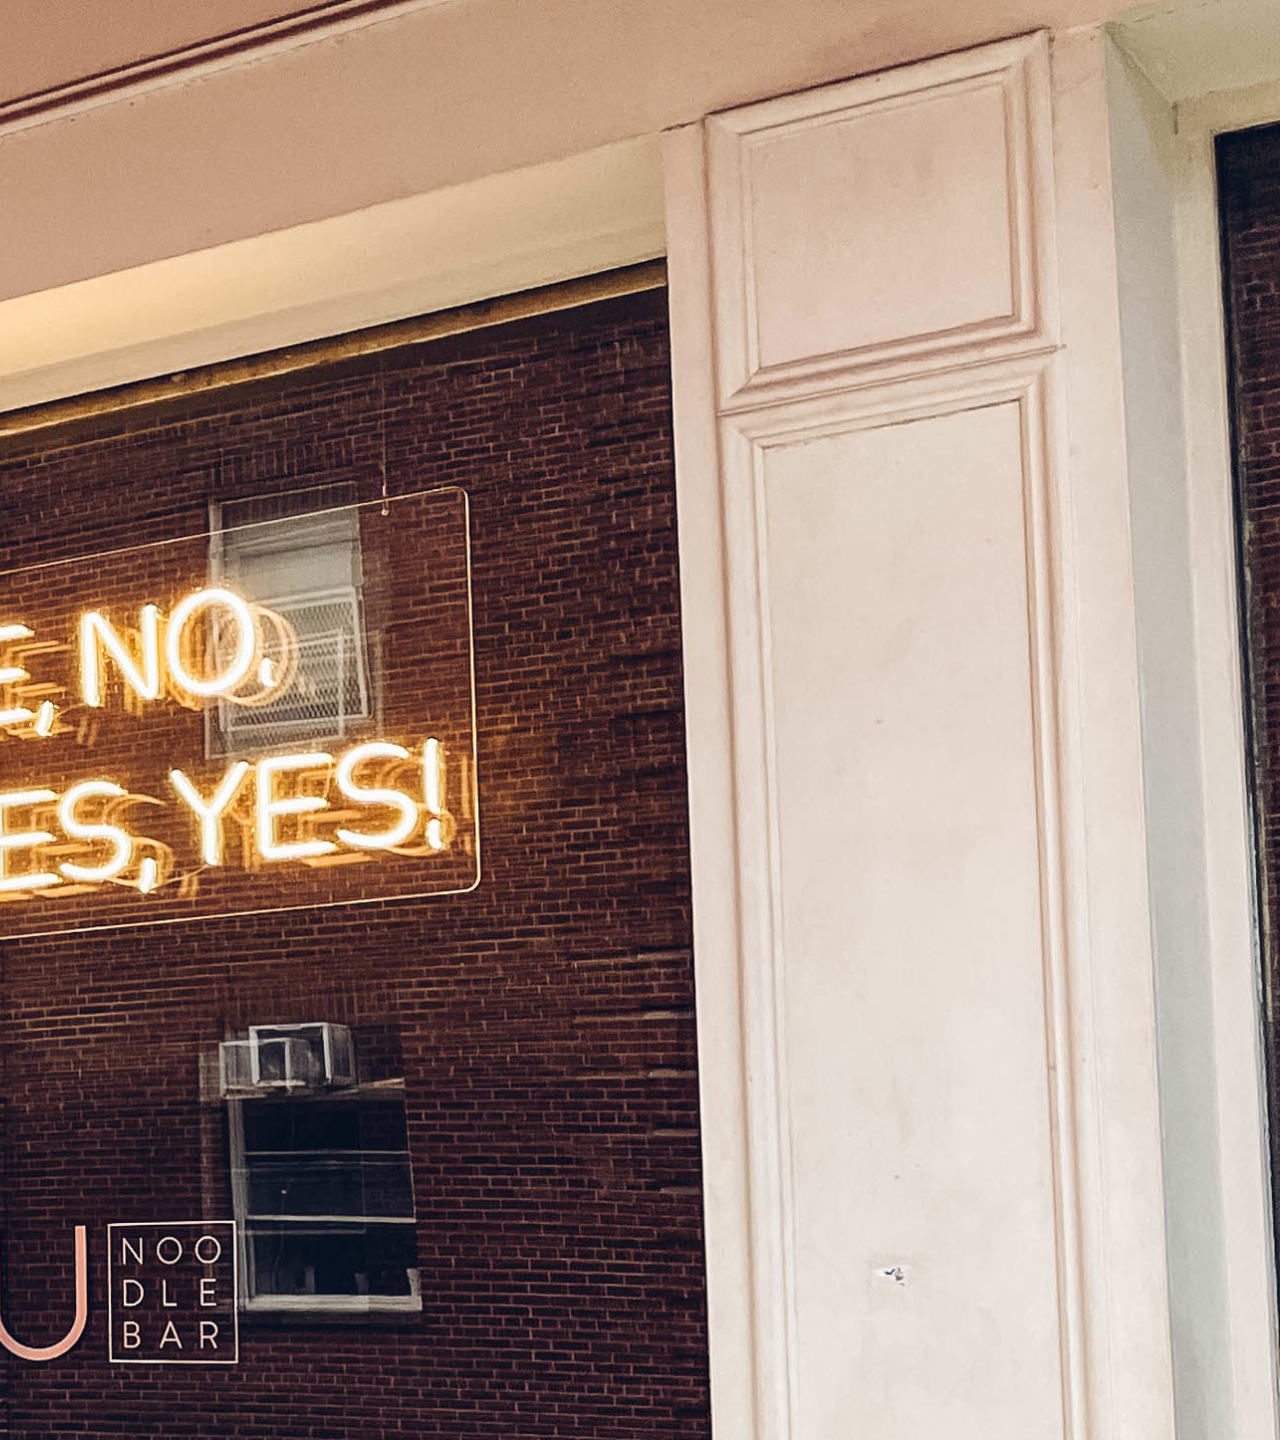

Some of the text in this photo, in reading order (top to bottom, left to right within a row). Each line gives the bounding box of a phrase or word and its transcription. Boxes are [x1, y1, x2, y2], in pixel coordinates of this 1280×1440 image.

[168, 735, 448, 868] YES!
[121, 1235, 222, 1267] NOO
[121, 1278, 218, 1308] DLE
[122, 1320, 220, 1350] BAR
